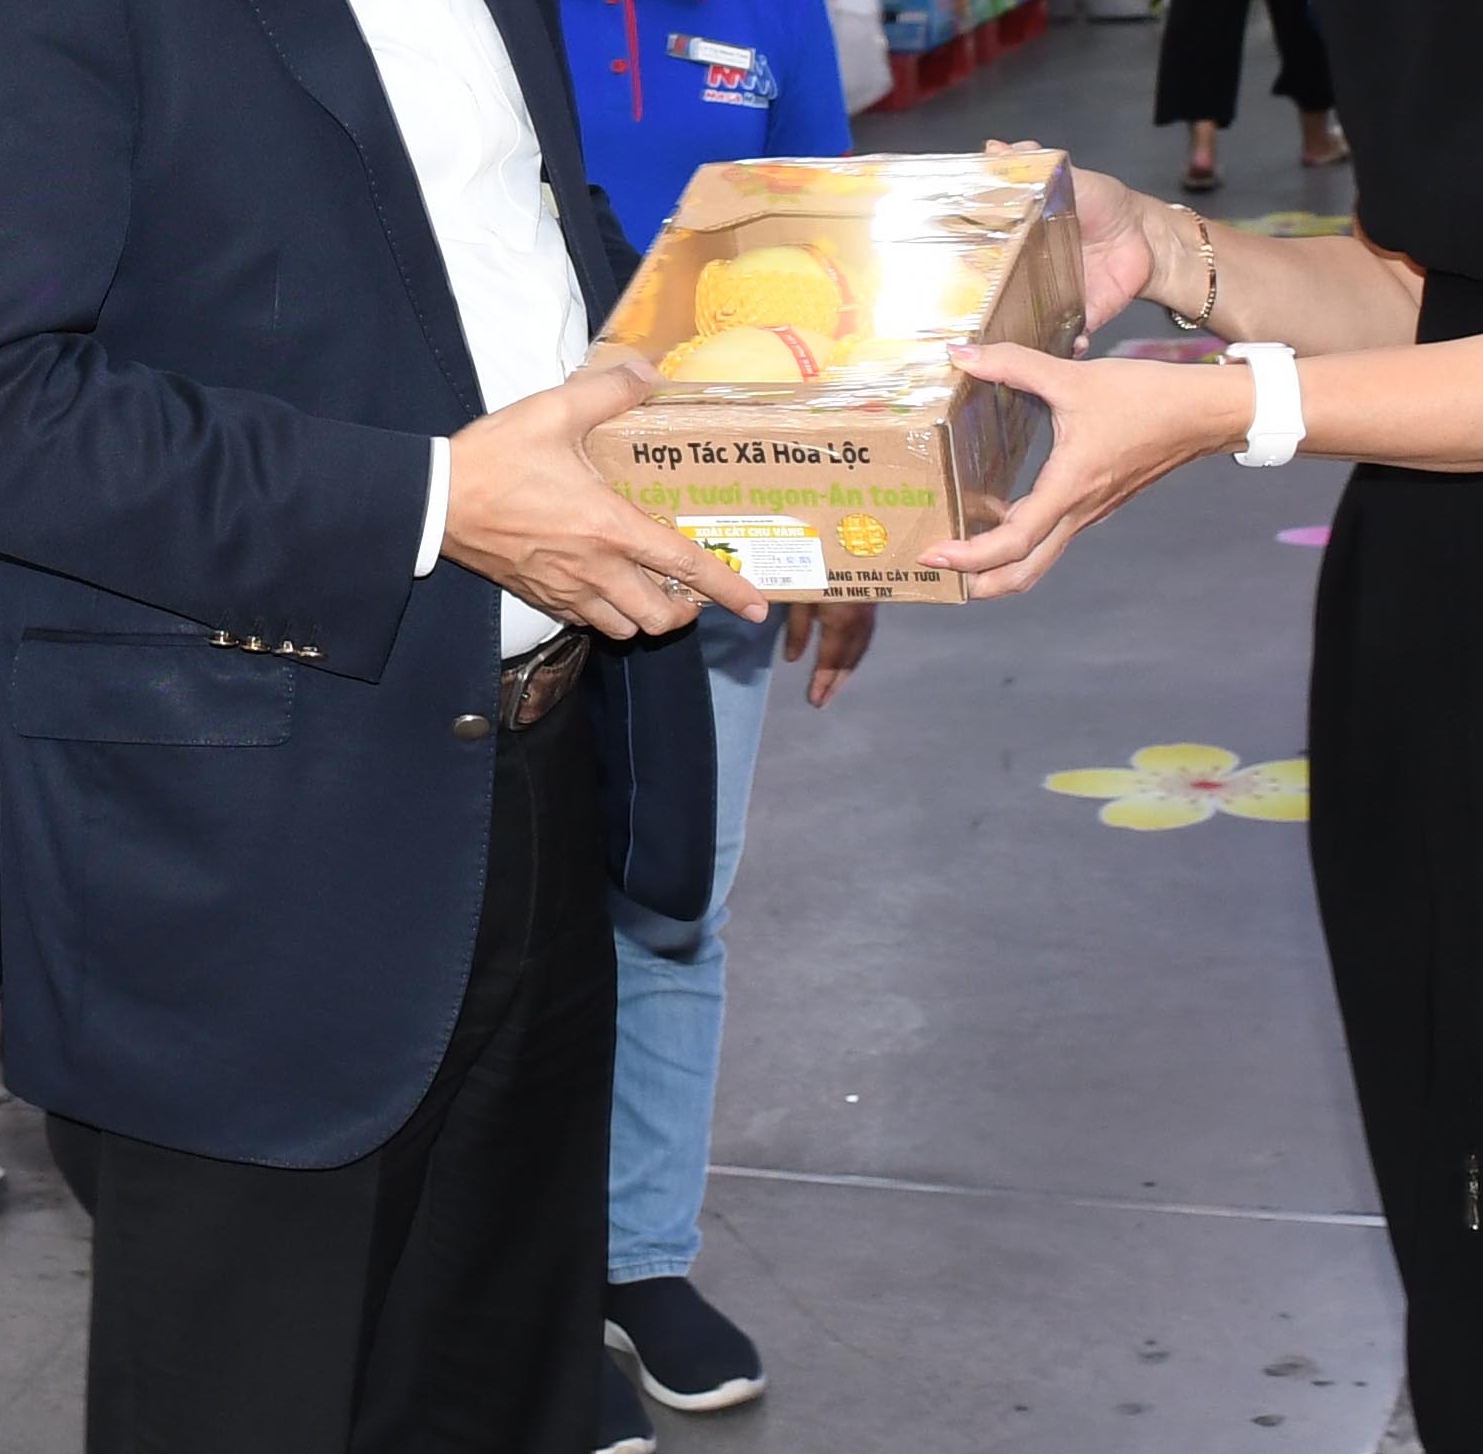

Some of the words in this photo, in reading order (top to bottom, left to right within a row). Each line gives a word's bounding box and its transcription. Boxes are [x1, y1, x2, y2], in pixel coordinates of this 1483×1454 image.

[633, 442, 683, 470] Hợp
[688, 440, 727, 464] Tác
[733, 443, 766, 464] Xã
[773, 443, 821, 464] Hòa
[827, 443, 871, 471] Lộc
[640, 482, 682, 511] cây
[688, 482, 741, 506] tươi
[827, 568, 853, 583] ÀNG
[857, 568, 883, 583] TRÁI
[886, 569, 910, 583] CÂY
[874, 585, 894, 598] TAY
